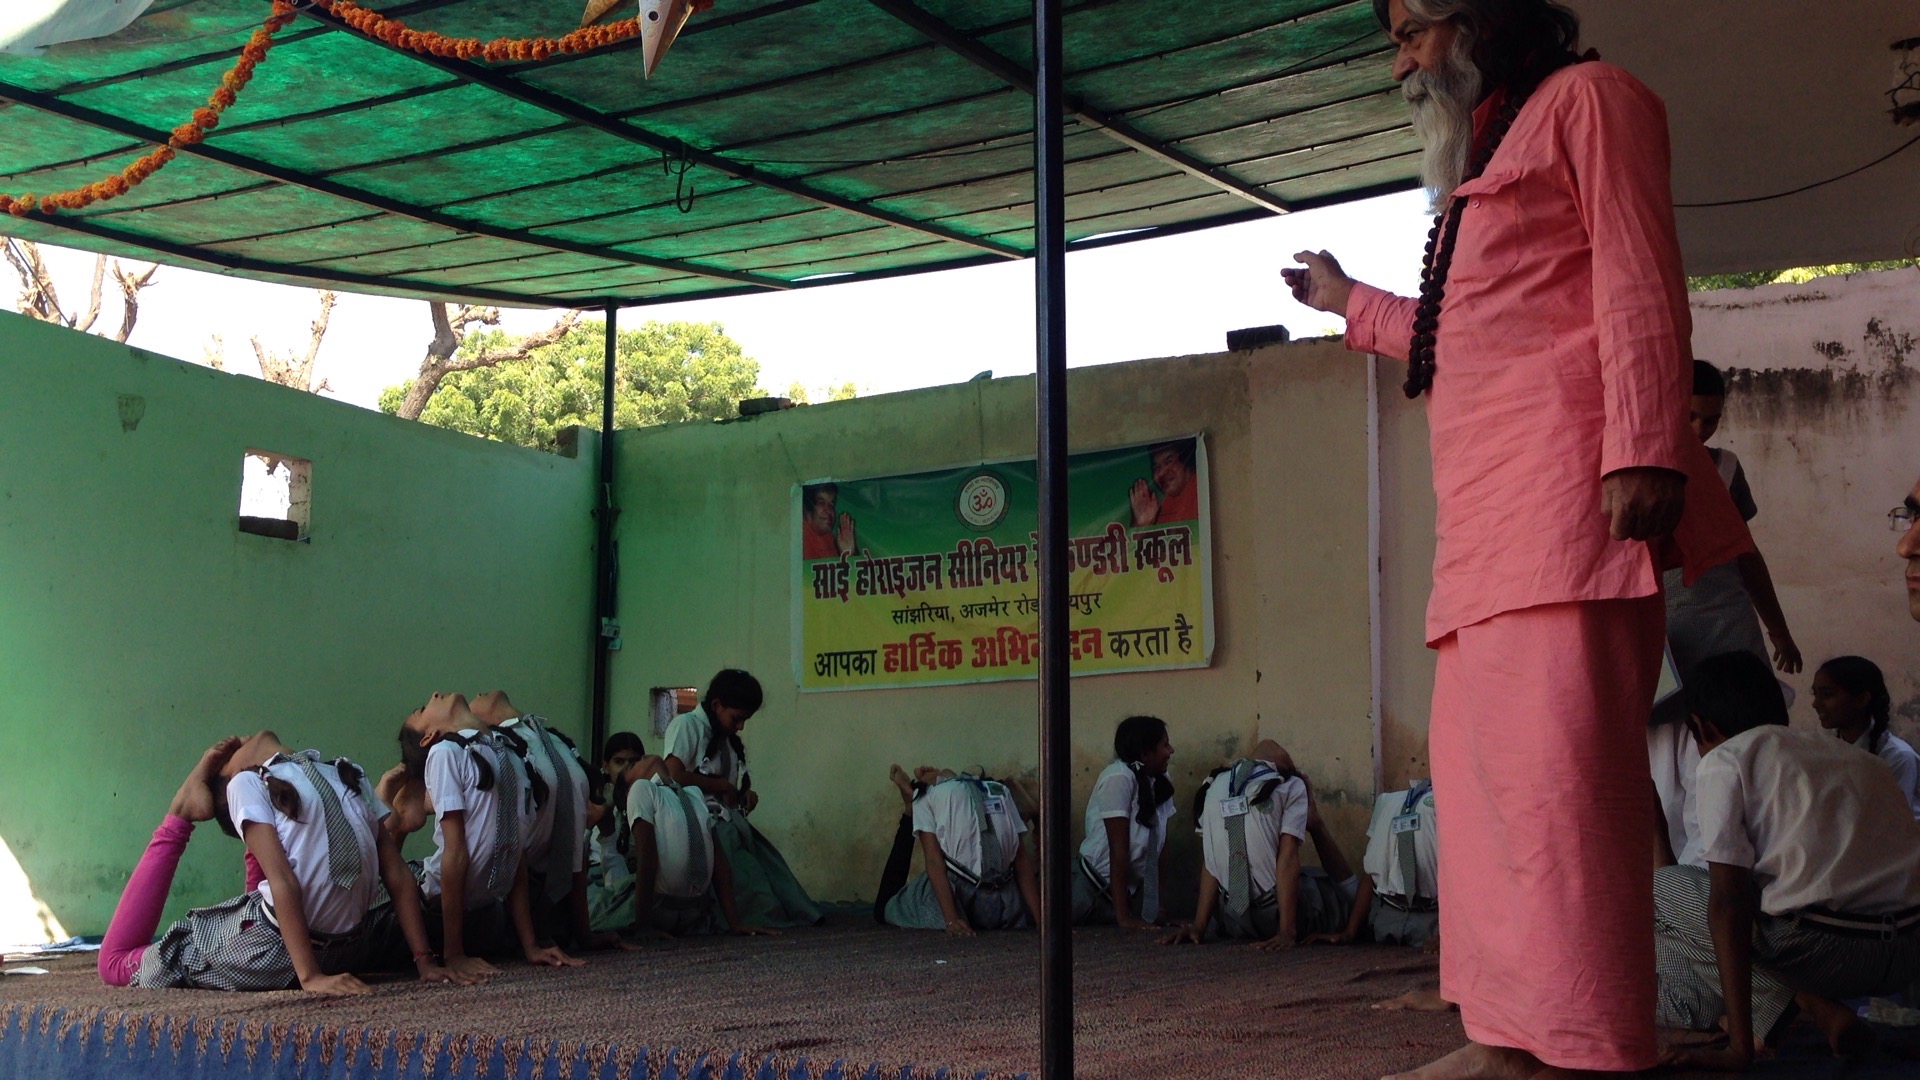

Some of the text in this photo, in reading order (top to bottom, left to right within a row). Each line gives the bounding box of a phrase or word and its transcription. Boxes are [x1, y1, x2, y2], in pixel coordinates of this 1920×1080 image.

[855, 549, 943, 599] होराइजन
[949, 538, 1028, 588] सीनियर
[1031, 523, 1128, 575] ण्डरी
[1133, 526, 1192, 583] स्कूल
[960, 596, 1010, 619] अजमेर
[1067, 593, 1102, 614] यपुर
[814, 613, 1193, 677] आपका हार्दिक अभिदन करता है
